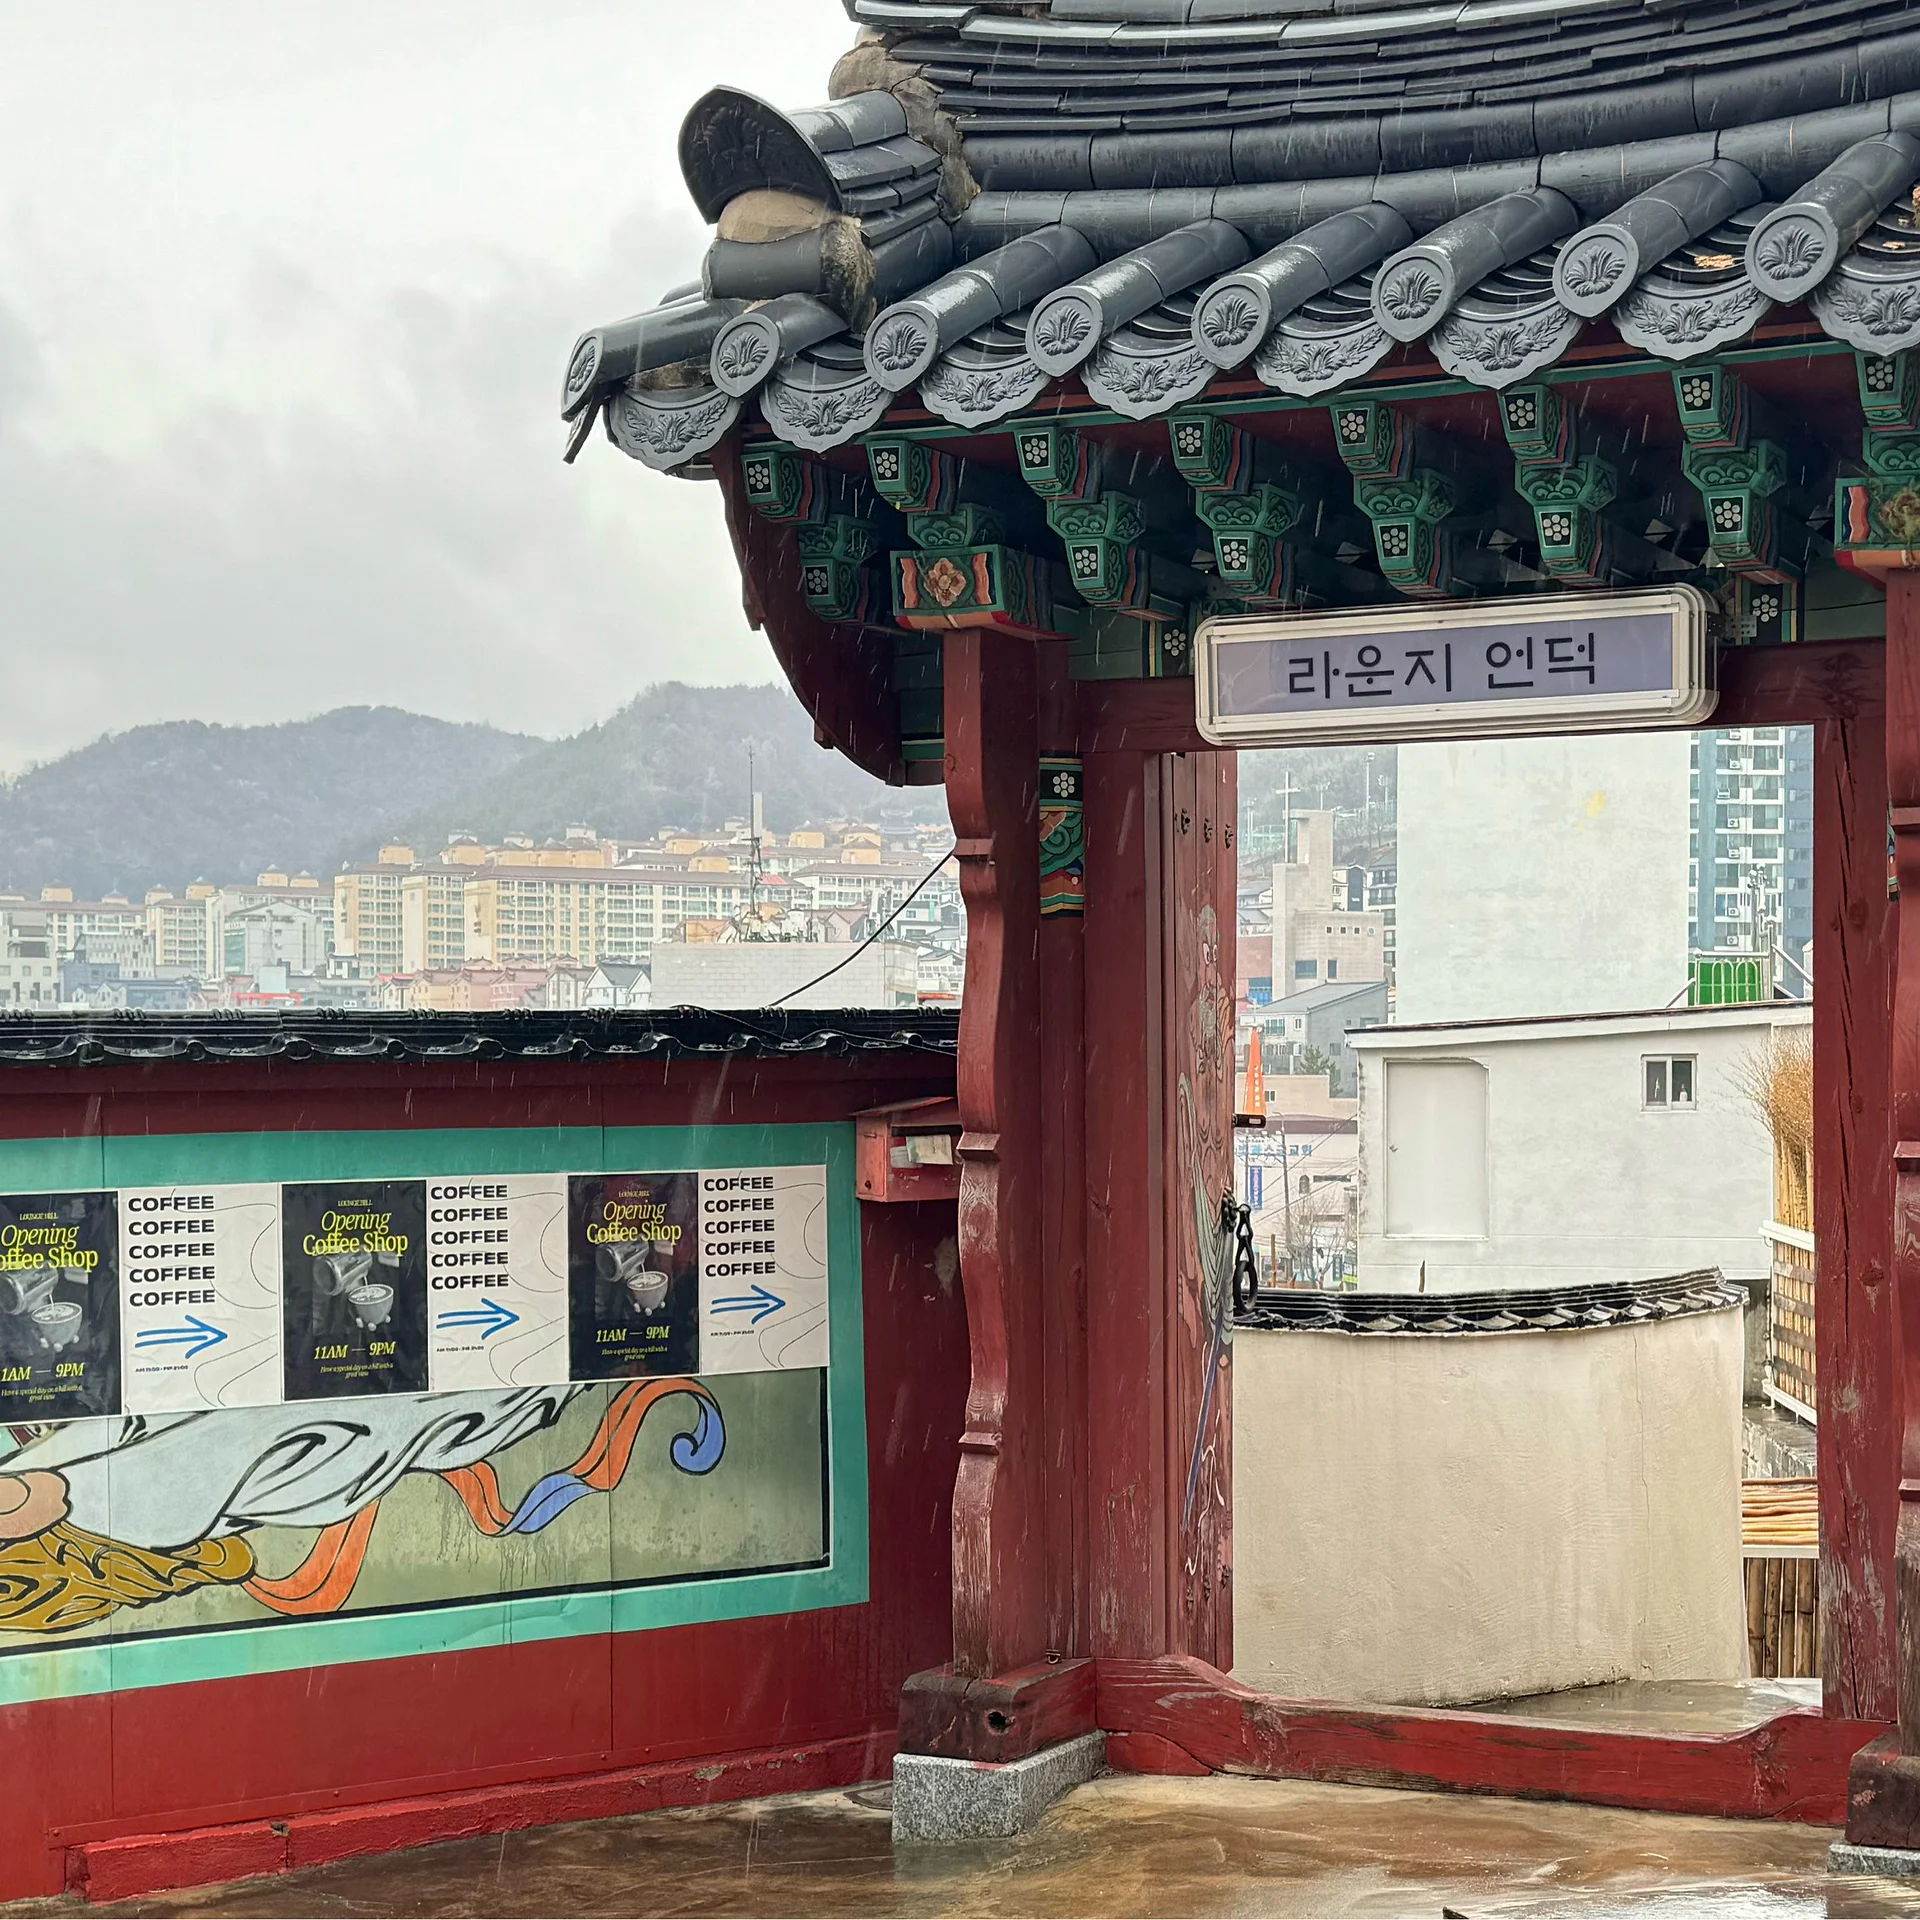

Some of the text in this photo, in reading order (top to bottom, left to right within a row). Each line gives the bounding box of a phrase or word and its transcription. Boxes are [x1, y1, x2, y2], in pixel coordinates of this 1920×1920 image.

[1288, 632, 1595, 699] 라운지 언덕
[430, 1184, 508, 1200] COFFEE
[703, 1176, 774, 1192] COFFEE
[128, 1195, 214, 1212] COFFEE
[603, 1199, 667, 1225] Opening
[704, 1197, 775, 1213] COFFEE
[321, 1208, 392, 1235] Opening
[430, 1207, 508, 1223] COFFEE
[128, 1219, 215, 1236] COFFEE
[586, 1221, 682, 1246] Coffee Shop
[704, 1219, 775, 1235] COFFEE
[1, 1222, 80, 1251] Opening
[303, 1231, 409, 1257] Coffee Shop
[431, 1229, 509, 1245] COFFEE
[128, 1242, 215, 1259] COFFEE
[704, 1240, 776, 1256] COFFEE
[0, 1246, 99, 1273] offee Shop
[431, 1251, 509, 1268] COFFEE
[129, 1266, 215, 1283] COFFEE
[705, 1261, 776, 1278] COFFEE
[431, 1274, 509, 1290] COFFEE
[129, 1289, 215, 1307] COFFEE
[595, 1328, 628, 1343] 11AM
[645, 1325, 671, 1340] 9PM
[314, 1344, 348, 1360] 11AM
[369, 1341, 397, 1356] 9PM
[0, 1366, 32, 1382] 1AM
[55, 1362, 86, 1378] 9PM
